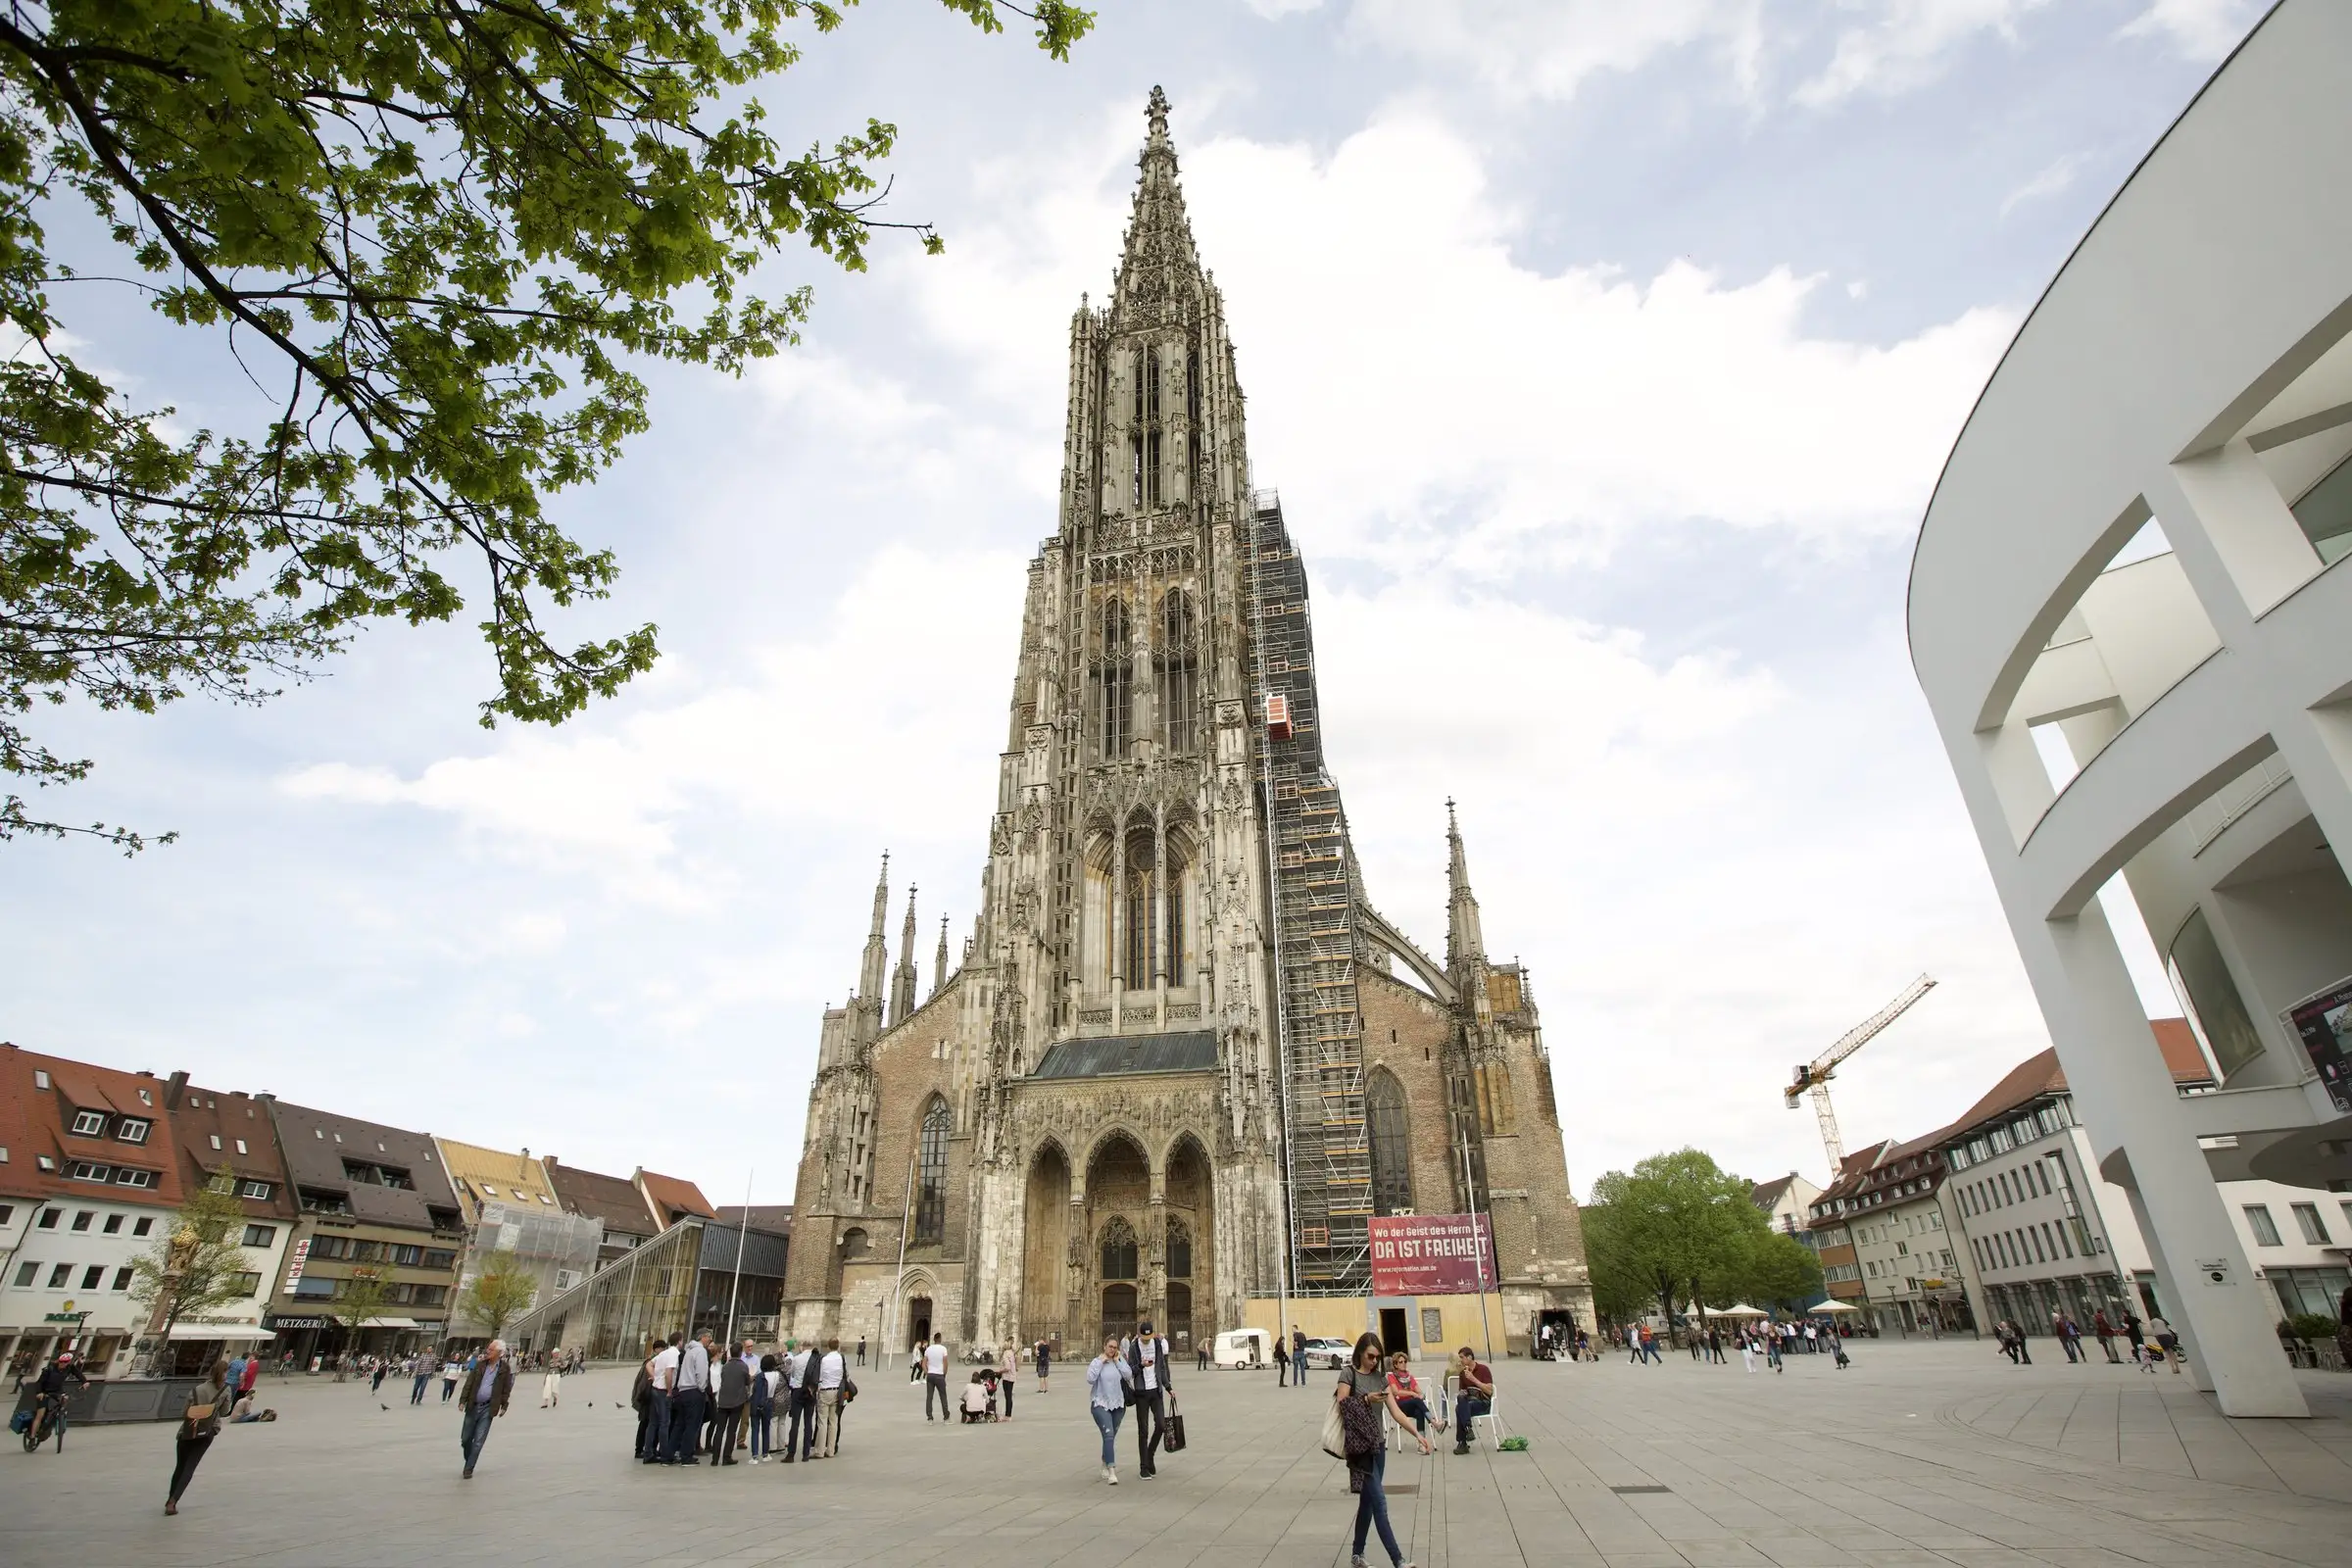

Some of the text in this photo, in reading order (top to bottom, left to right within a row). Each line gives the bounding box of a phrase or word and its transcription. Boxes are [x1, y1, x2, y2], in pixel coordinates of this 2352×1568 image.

[1374, 1224, 1485, 1238] Wo der Geist des Herrn st
[1375, 1237, 1487, 1259] DA IST FREIHET
